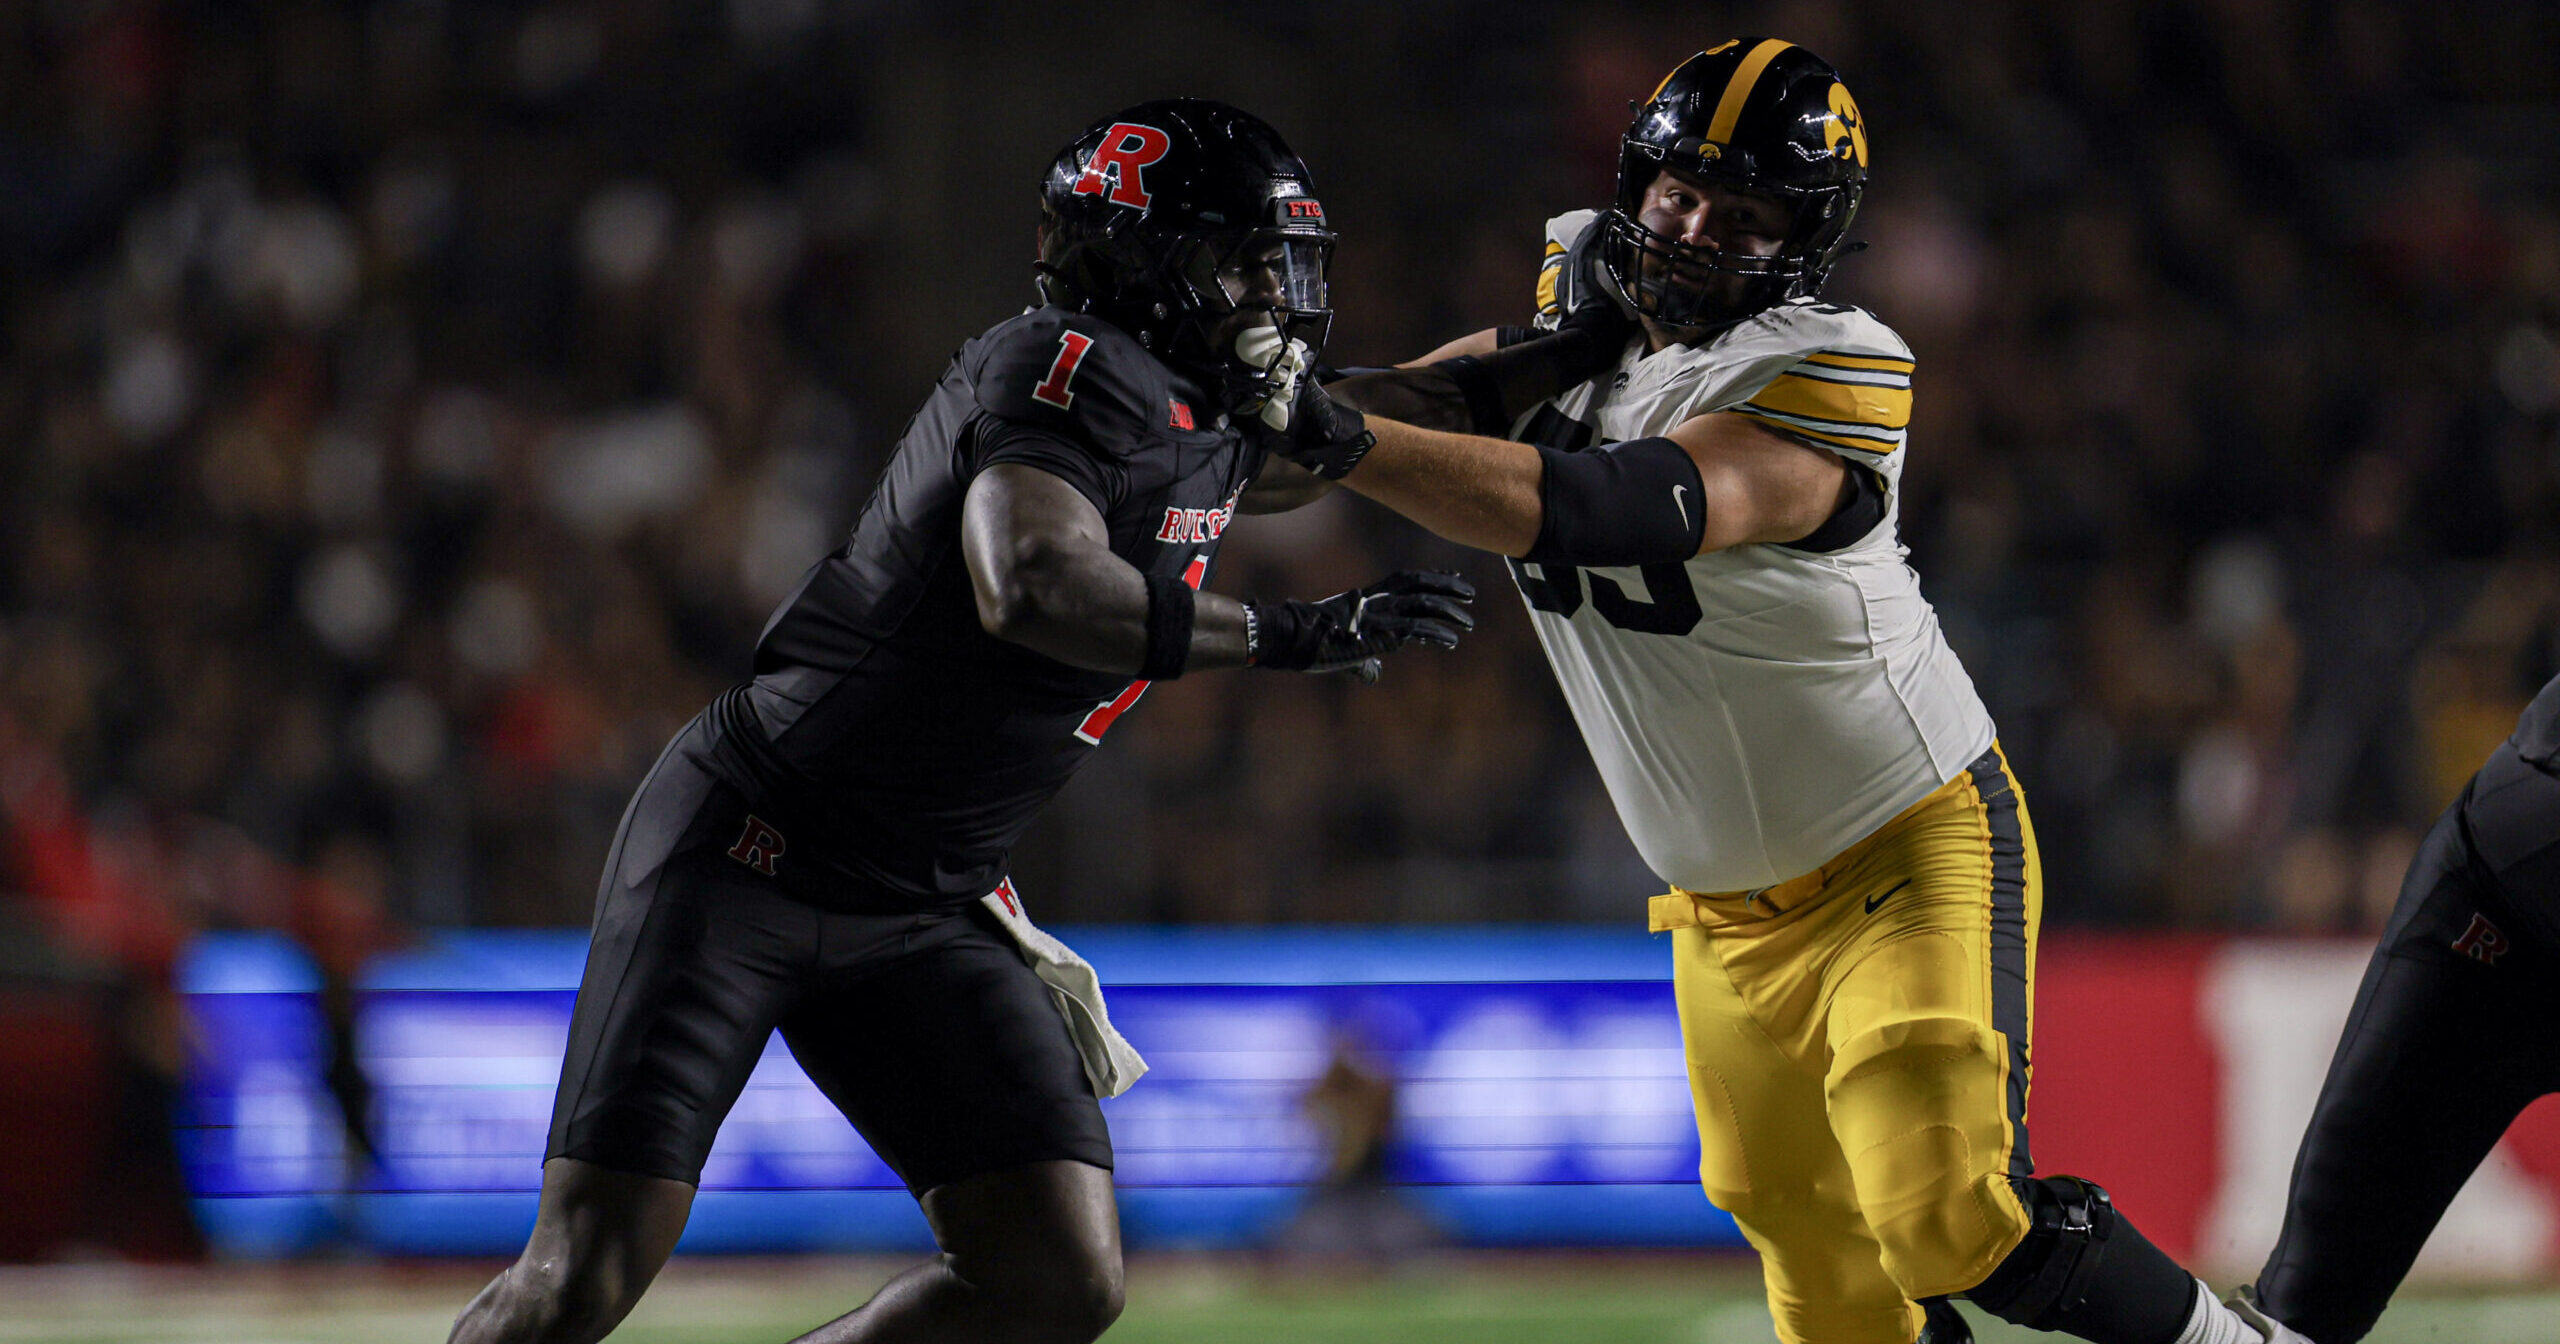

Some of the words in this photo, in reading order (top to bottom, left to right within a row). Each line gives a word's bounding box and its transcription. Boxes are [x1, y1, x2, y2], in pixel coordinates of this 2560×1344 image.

[1072, 121, 1171, 210] R
[1032, 329, 1095, 411] 1
[727, 814, 787, 876] R
[2451, 911, 2510, 968] R
